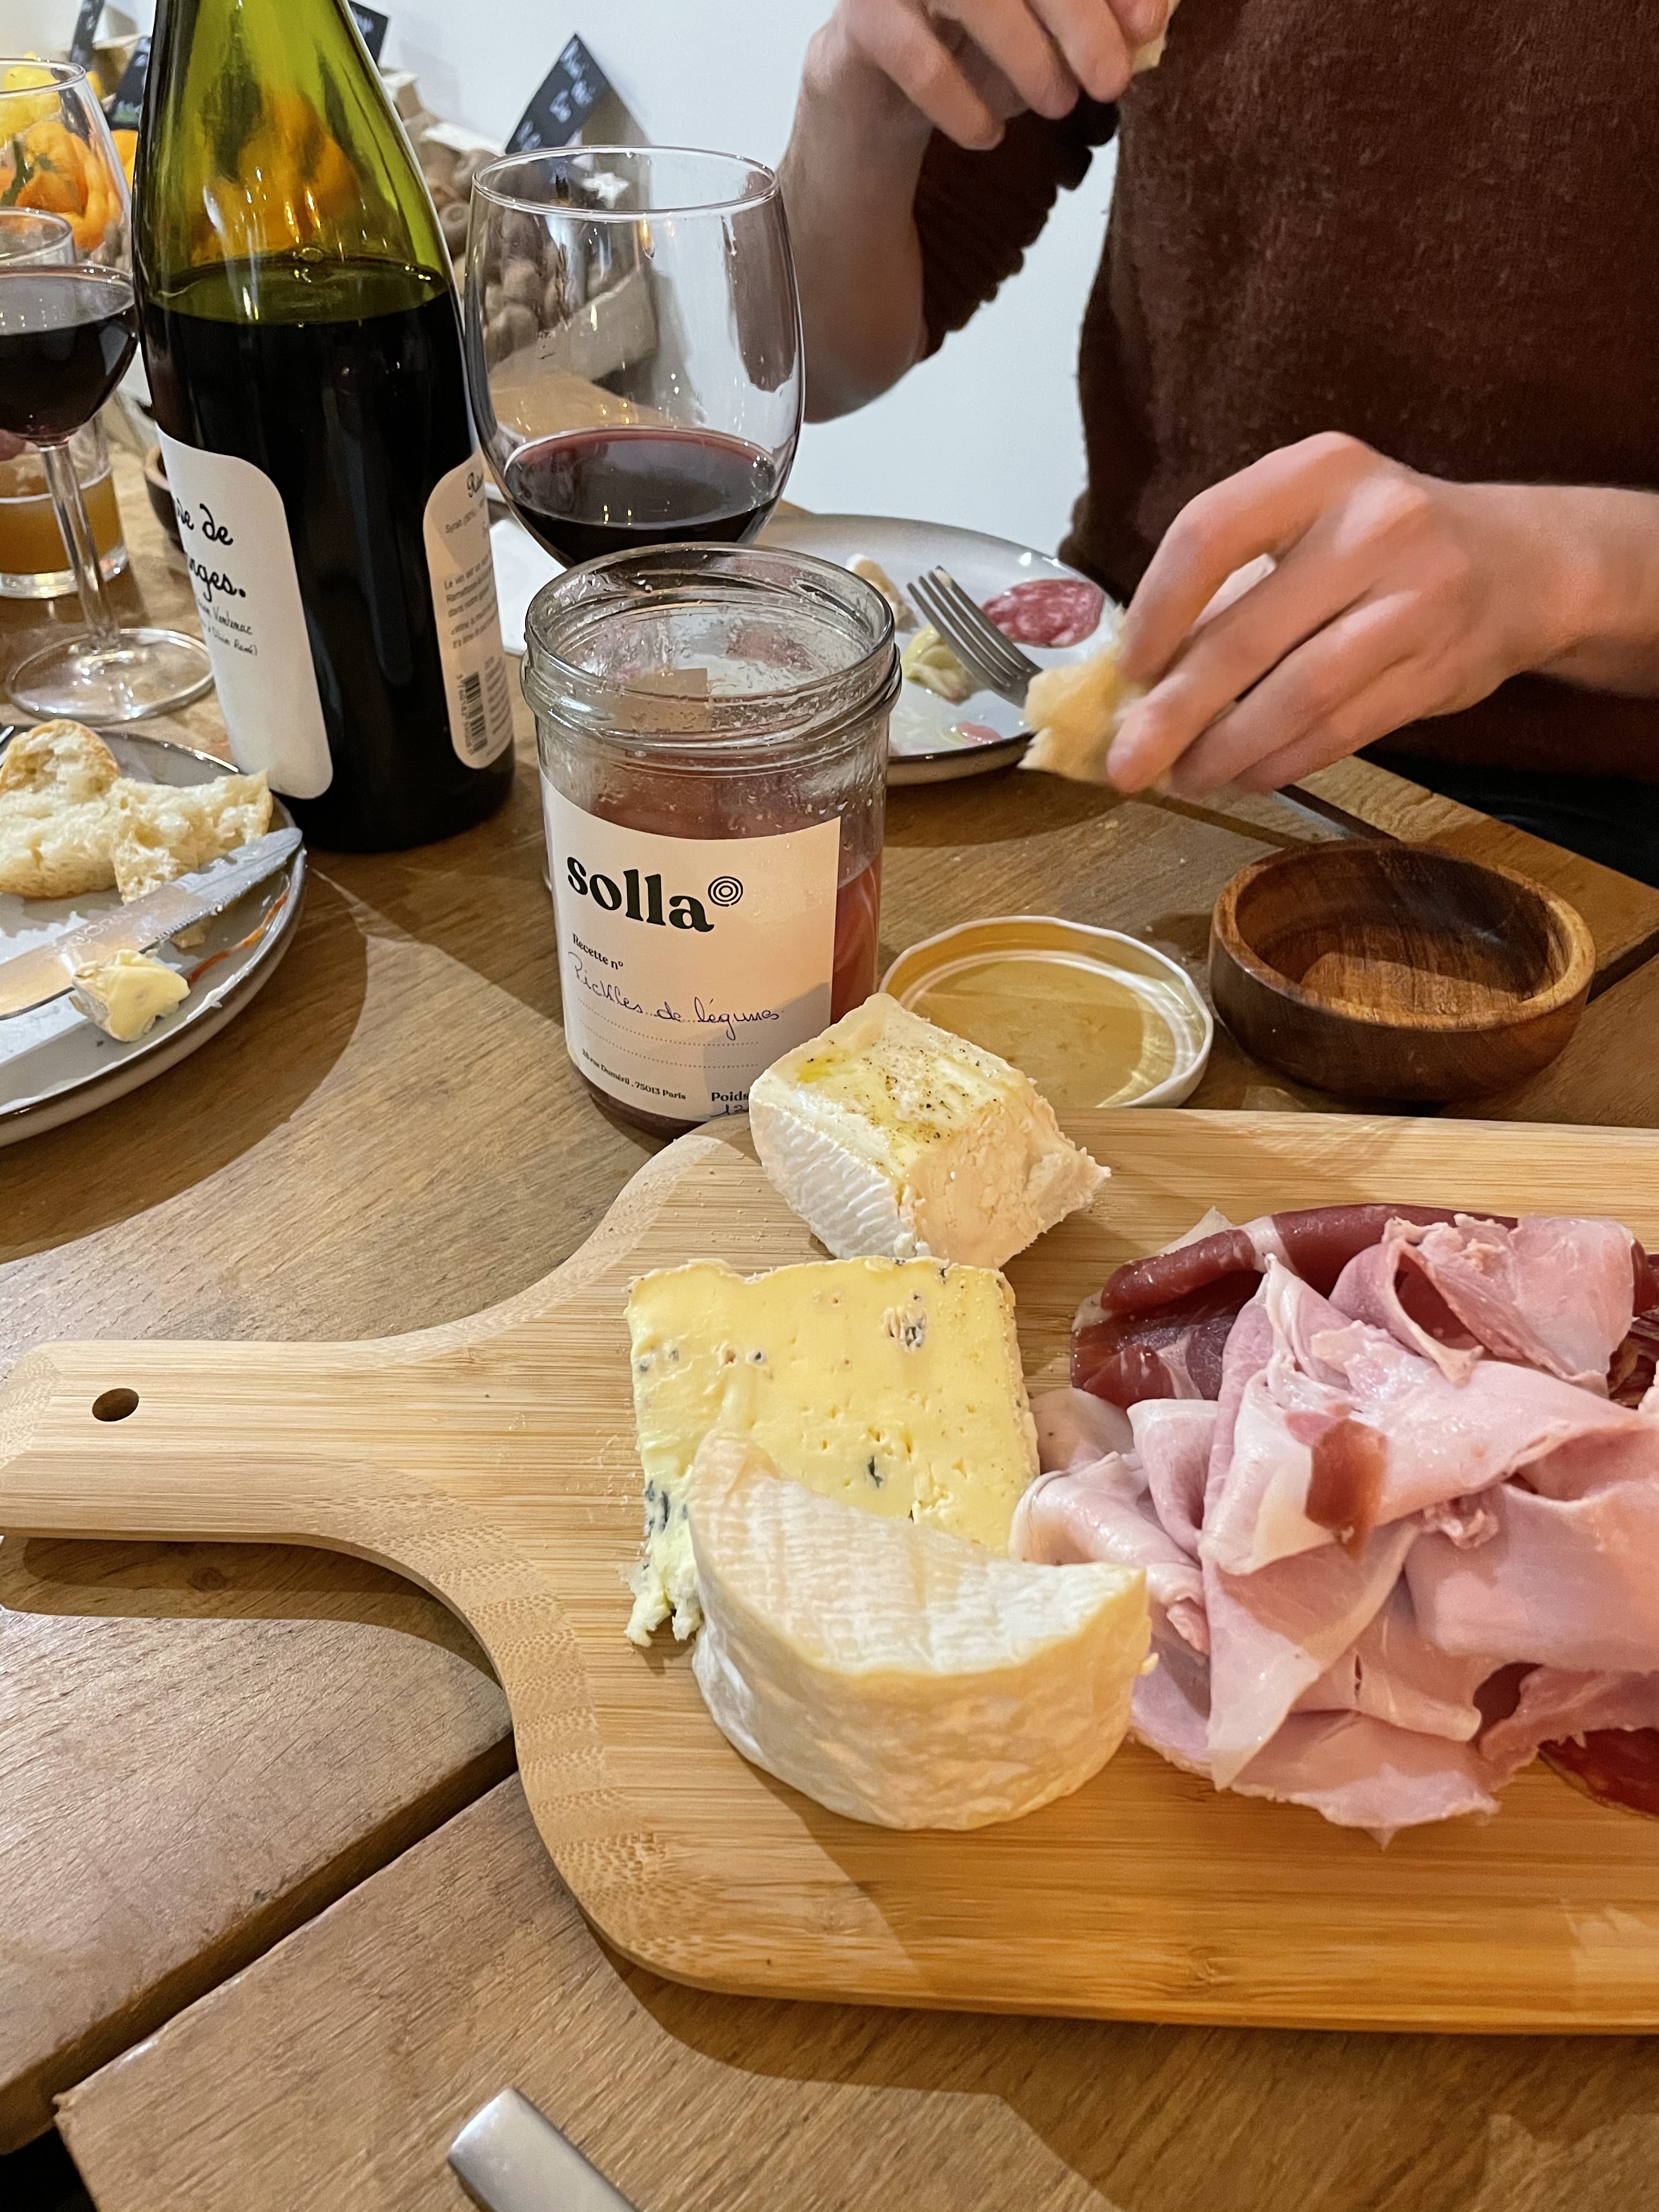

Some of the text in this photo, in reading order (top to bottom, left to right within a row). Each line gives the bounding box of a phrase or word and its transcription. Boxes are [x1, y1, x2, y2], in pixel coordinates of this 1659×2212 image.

[200, 503, 234, 545] de
[567, 856, 715, 933] solla
[573, 933, 608, 965] Recette
[653, 1001, 682, 1023] de
[635, 1081, 660, 1094] 75013
[663, 1089, 686, 1099] Paris
